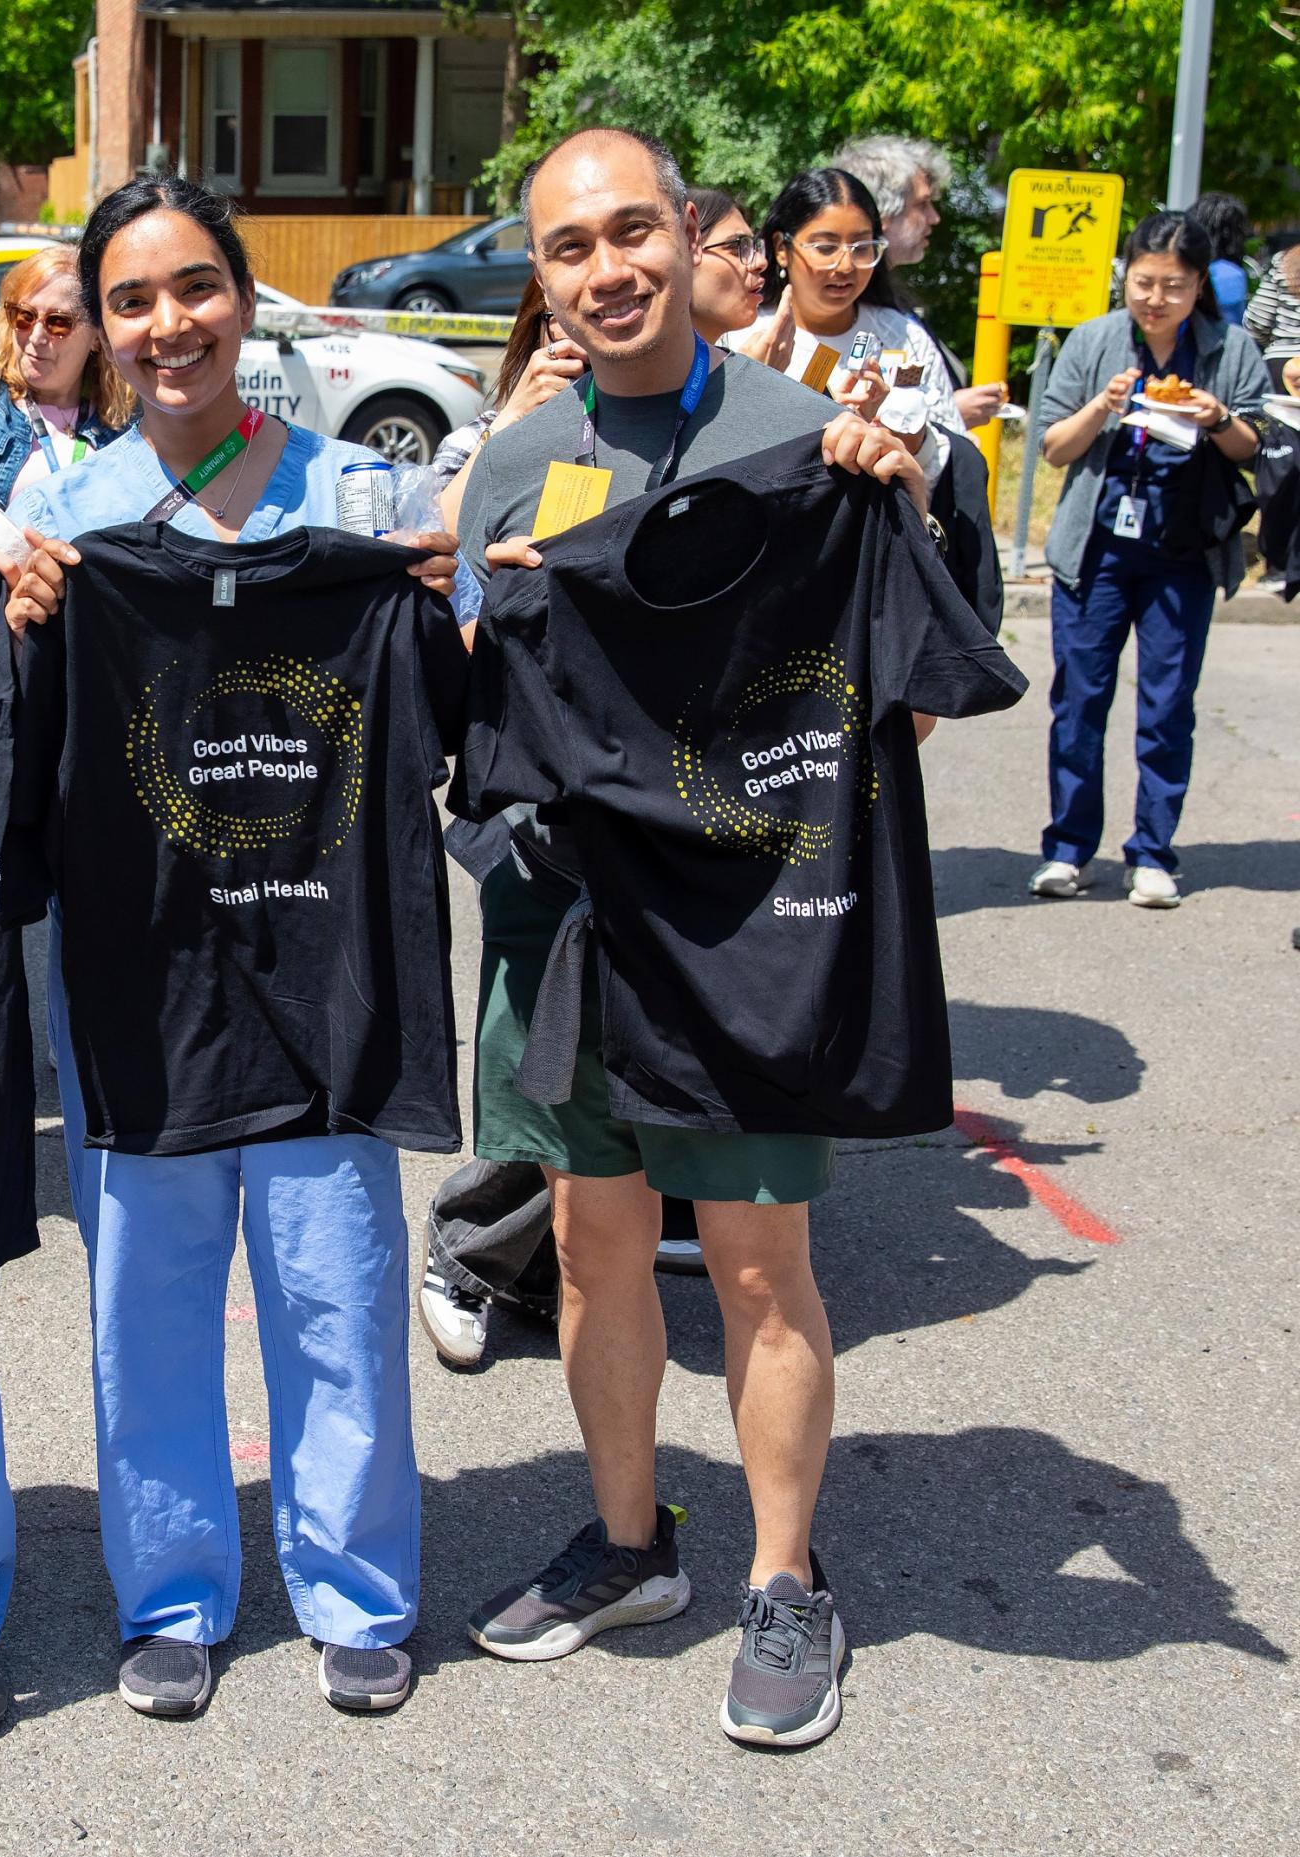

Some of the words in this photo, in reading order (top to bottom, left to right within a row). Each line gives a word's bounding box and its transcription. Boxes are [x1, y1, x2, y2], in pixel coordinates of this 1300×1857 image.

[1030, 182, 1104, 197] WARNING
[238, 370, 282, 389] adin
[247, 396, 302, 416] RITY
[193, 734, 247, 758] Good
[250, 734, 308, 753] Vibes
[741, 736, 798, 770] Good
[796, 729, 844, 752] Vibes
[188, 761, 245, 785] Great
[248, 759, 318, 783] People
[744, 764, 803, 798] Great
[801, 760, 839, 782] Peop
[210, 882, 259, 905] Sinai
[263, 880, 329, 900] Health
[773, 896, 815, 917] Sinai
[816, 891, 858, 917] Halth
